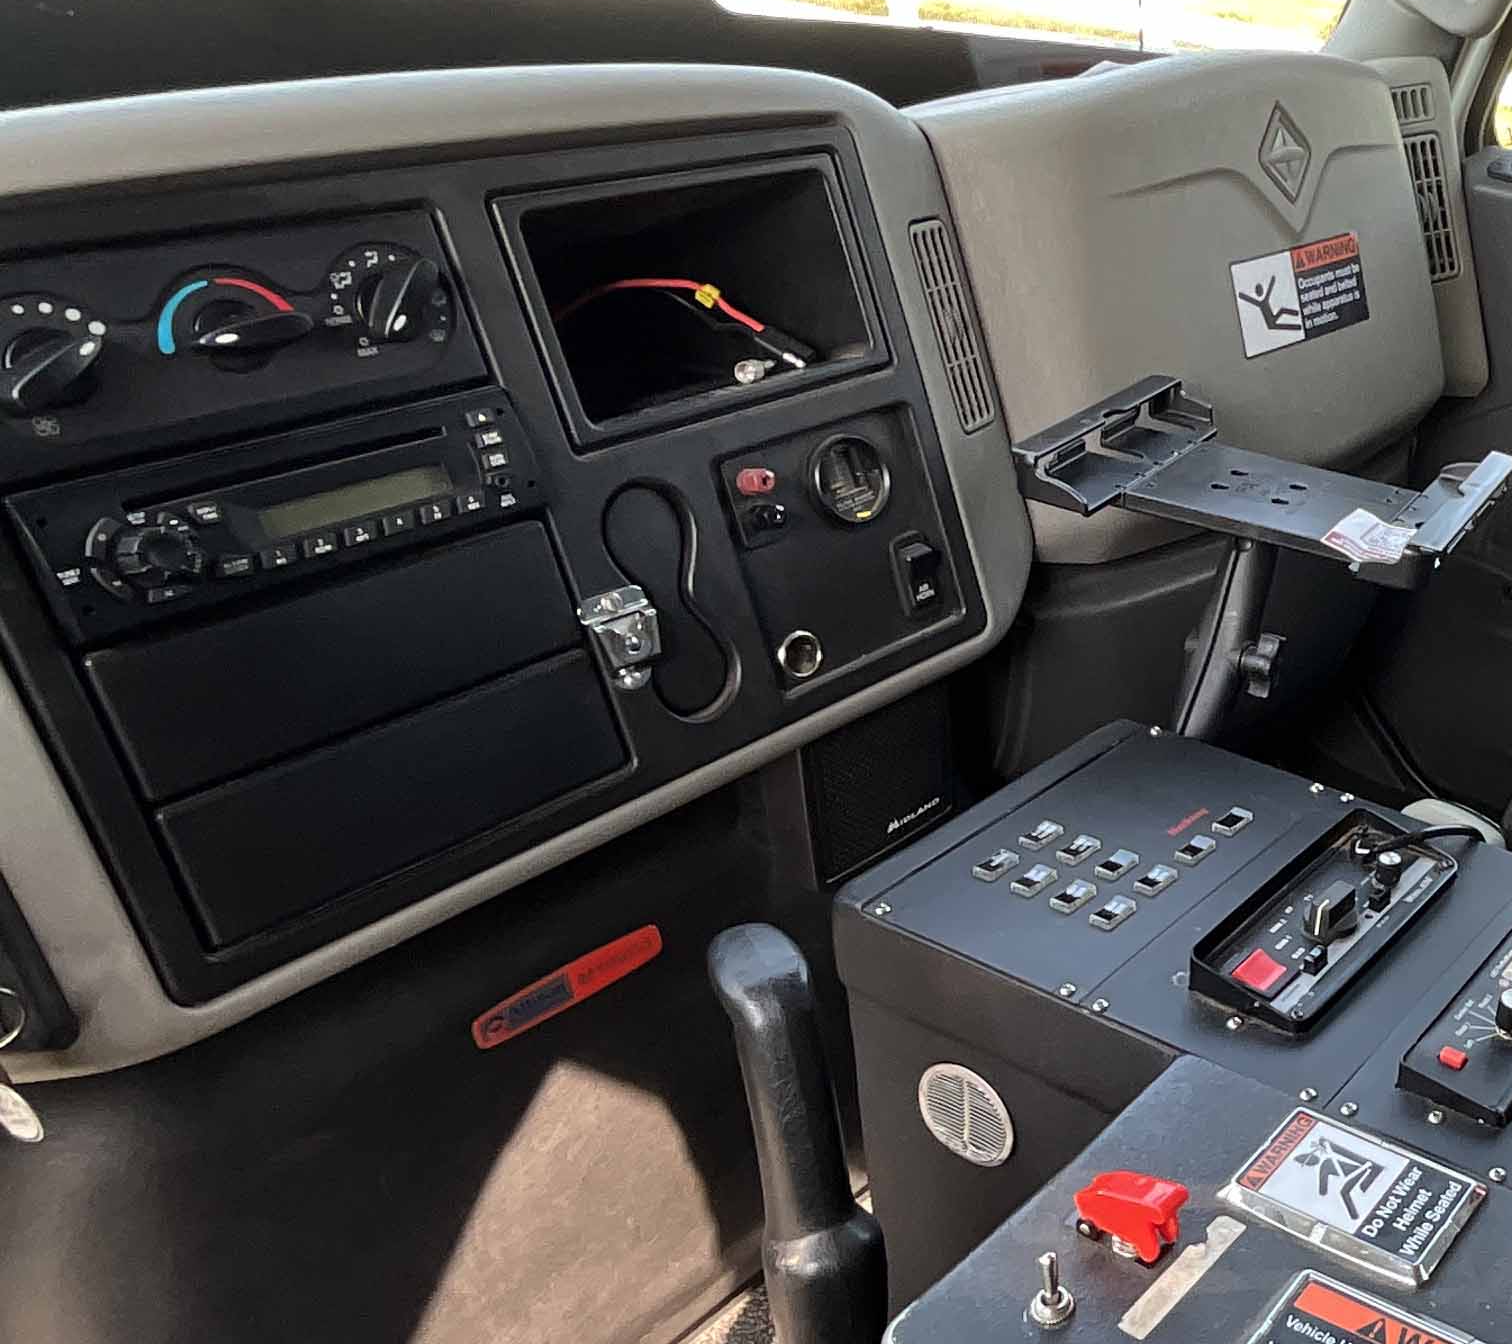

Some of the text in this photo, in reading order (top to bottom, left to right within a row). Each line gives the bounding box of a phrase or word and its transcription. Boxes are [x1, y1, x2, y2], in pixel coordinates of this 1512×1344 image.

[1305, 237, 1356, 264] WARNING
[1298, 271, 1335, 288] Occupants
[1351, 263, 1360, 274] be
[1324, 281, 1338, 296] and
[1304, 317, 1313, 329] in
[1253, 1117, 1313, 1173] WARNING
[1361, 1167, 1422, 1237] Do Not Wear
[1392, 1189, 1432, 1231] Helmet
[1399, 1180, 1462, 1255] While Seated
